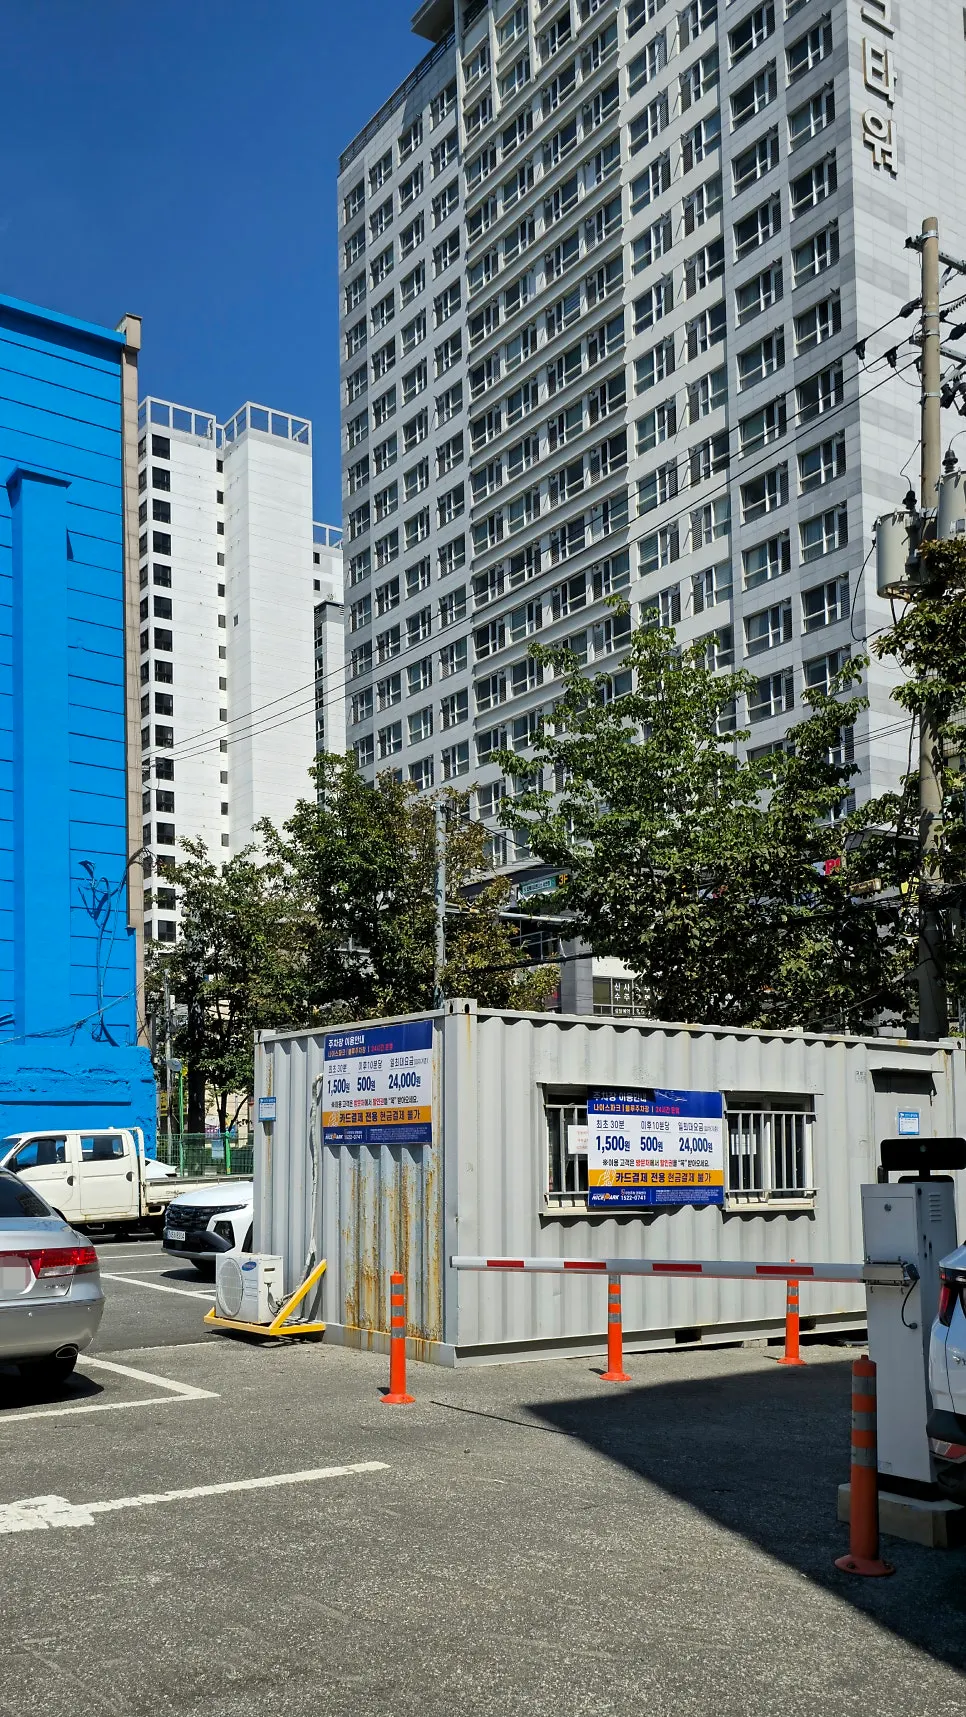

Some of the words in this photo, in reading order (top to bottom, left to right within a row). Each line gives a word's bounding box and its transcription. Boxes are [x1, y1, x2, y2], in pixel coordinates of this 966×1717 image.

[328, 1038, 344, 1048] 주차장
[344, 1035, 365, 1046] 이용안내
[328, 1078, 350, 1096] 1,500원
[357, 1076, 375, 1091] 500원
[388, 1072, 421, 1091] 24,000원
[593, 1091, 616, 1102] 주차장
[619, 1091, 647, 1103] 이용안내
[593, 1103, 621, 1111] 나이스파크
[340, 1112, 364, 1124] 카드결제
[365, 1111, 378, 1122] 전용
[380, 1110, 405, 1122] 현금결제
[407, 1109, 421, 1120] 불가
[596, 1119, 609, 1129] 최초
[610, 1120, 625, 1129] 30분
[678, 1121, 704, 1132] 일최대요금
[596, 1135, 631, 1153] 1,500원
[640, 1136, 664, 1152] 500원
[679, 1137, 713, 1154] 24,000원
[620, 1159, 635, 1167] 고객은
[616, 1172, 648, 1183] 카드결제
[651, 1172, 665, 1183] 전용
[668, 1172, 695, 1183] 현금결제
[697, 1172, 711, 1183] 불가
